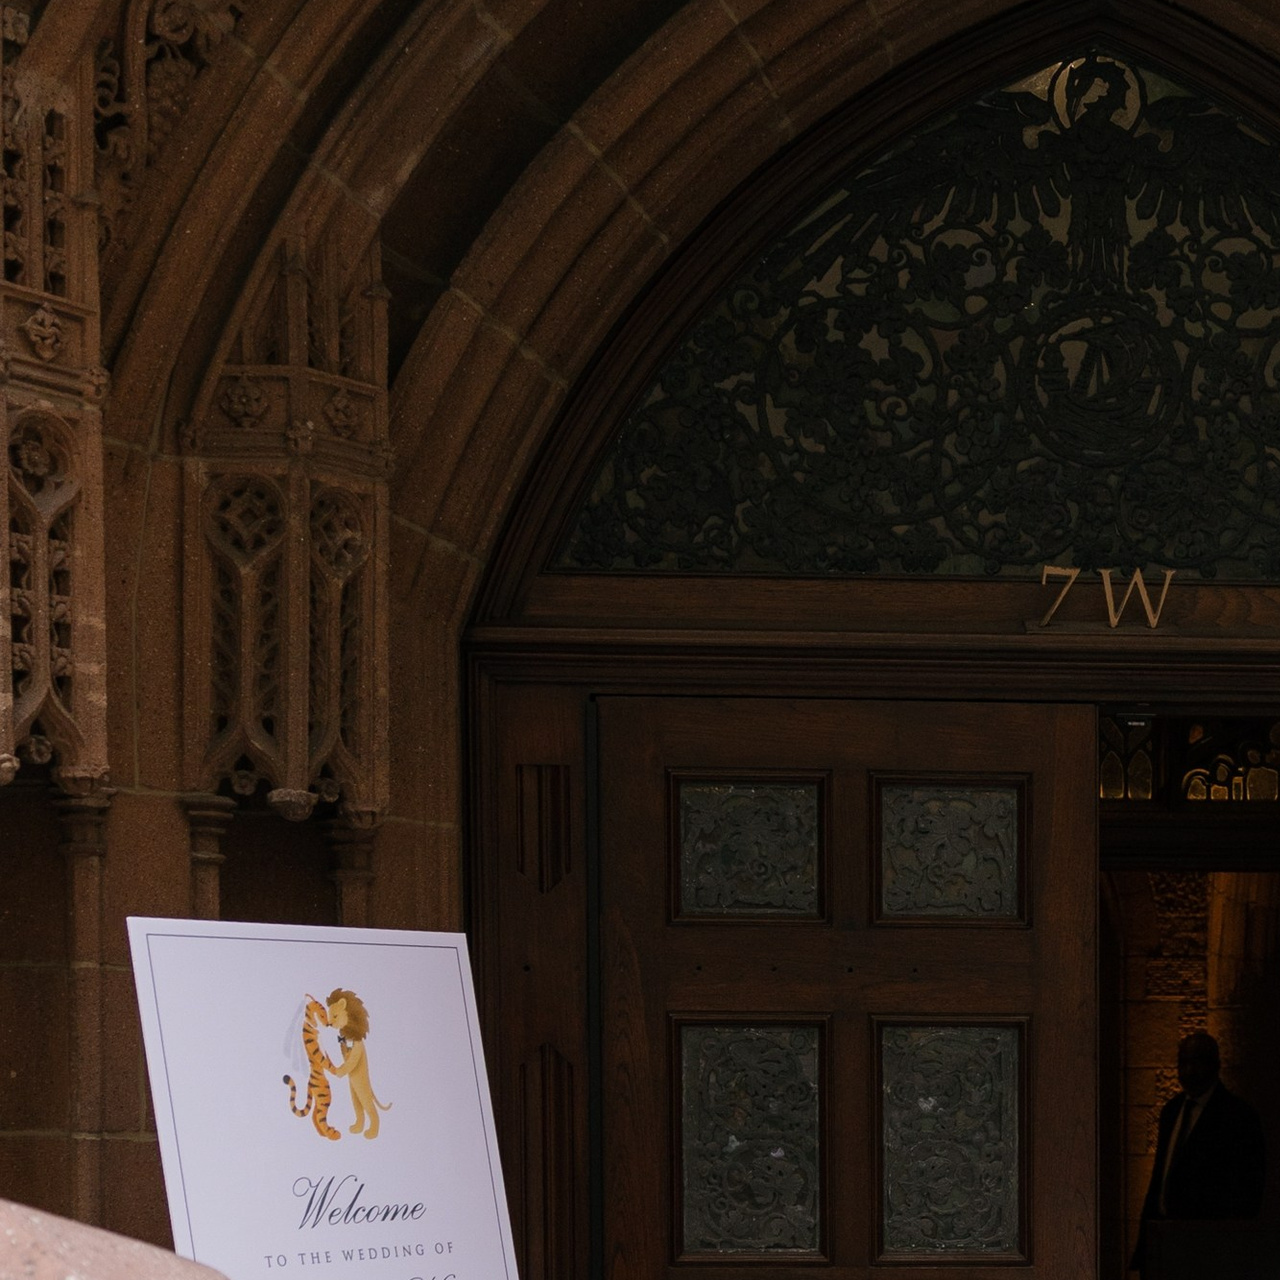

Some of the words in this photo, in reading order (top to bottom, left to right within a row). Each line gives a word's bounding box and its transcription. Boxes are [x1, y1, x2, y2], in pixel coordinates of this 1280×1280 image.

[292, 1174, 427, 1230] Welcome
[264, 1254, 288, 1268] TO
[298, 1251, 332, 1266] THE
[342, 1243, 425, 1262] WEDDING
[434, 1241, 454, 1255] OF
